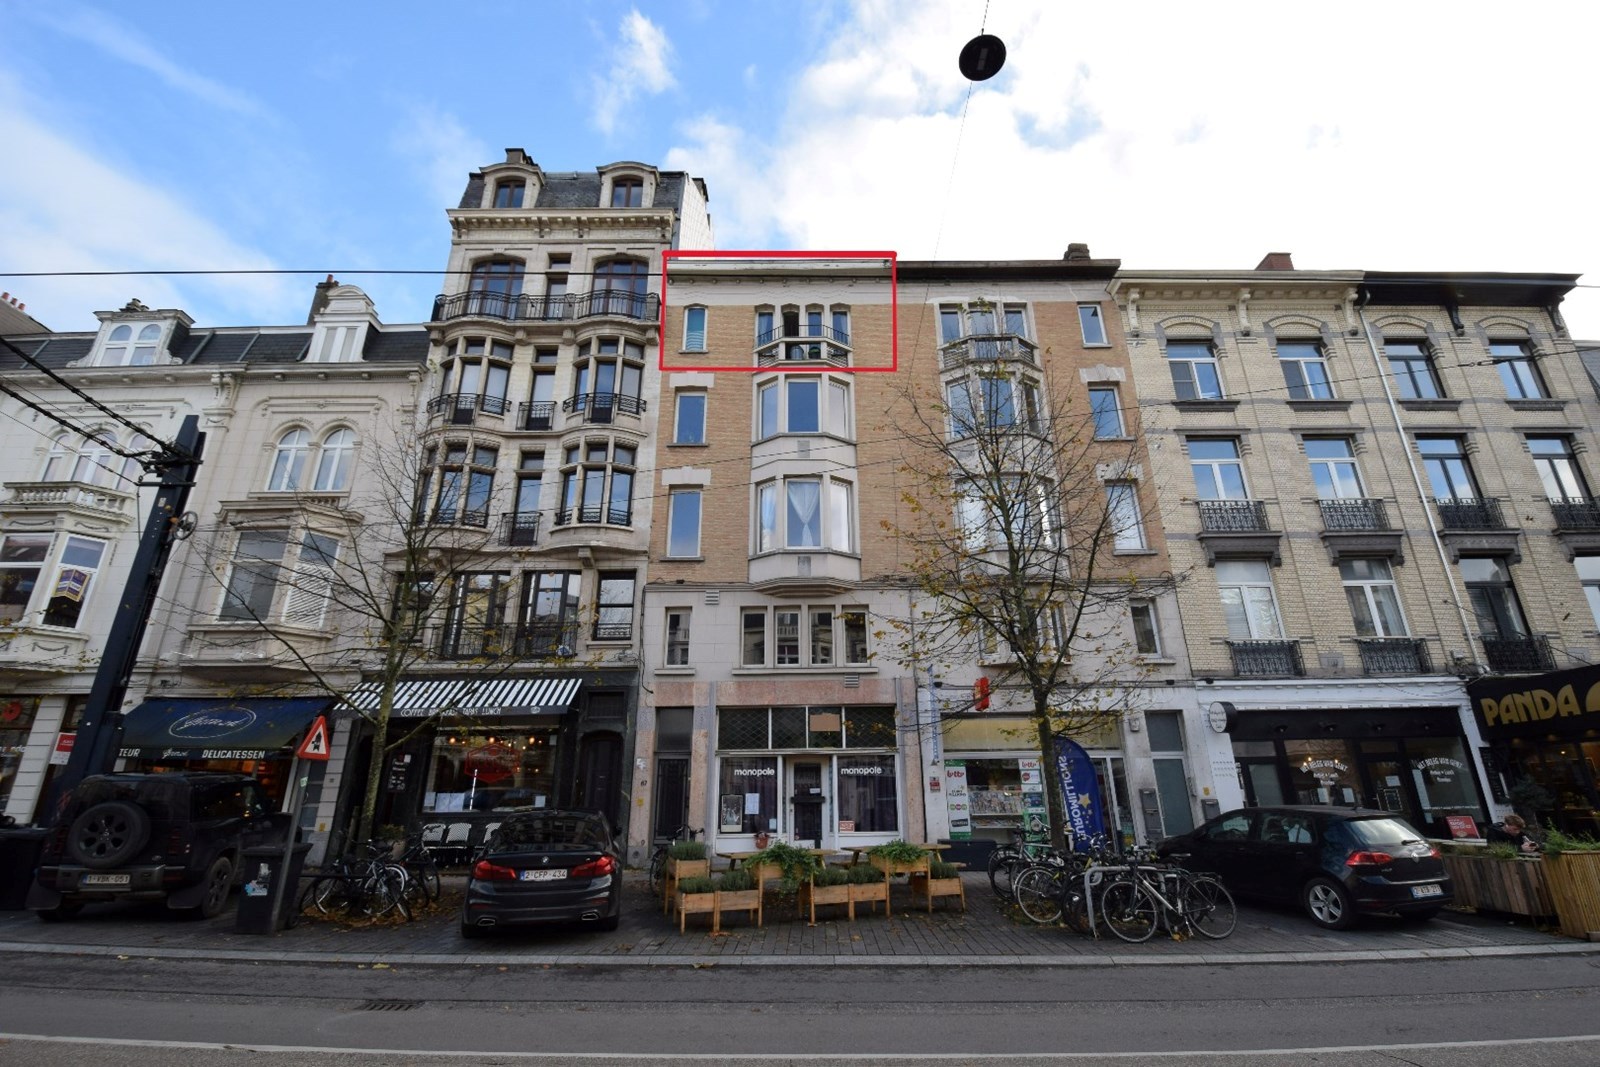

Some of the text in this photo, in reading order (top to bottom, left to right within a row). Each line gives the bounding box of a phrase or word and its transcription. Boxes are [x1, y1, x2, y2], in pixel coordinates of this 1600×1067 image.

[1480, 684, 1582, 727] PANDA
[201, 750, 266, 760] DELICATESSEN
[734, 767, 775, 777] monopole
[840, 766, 882, 776] monopole
[946, 770, 965, 778] lotto
[88, 875, 128, 883] 1-VBK-051
[525, 870, 566, 879] 2-CFP-434
